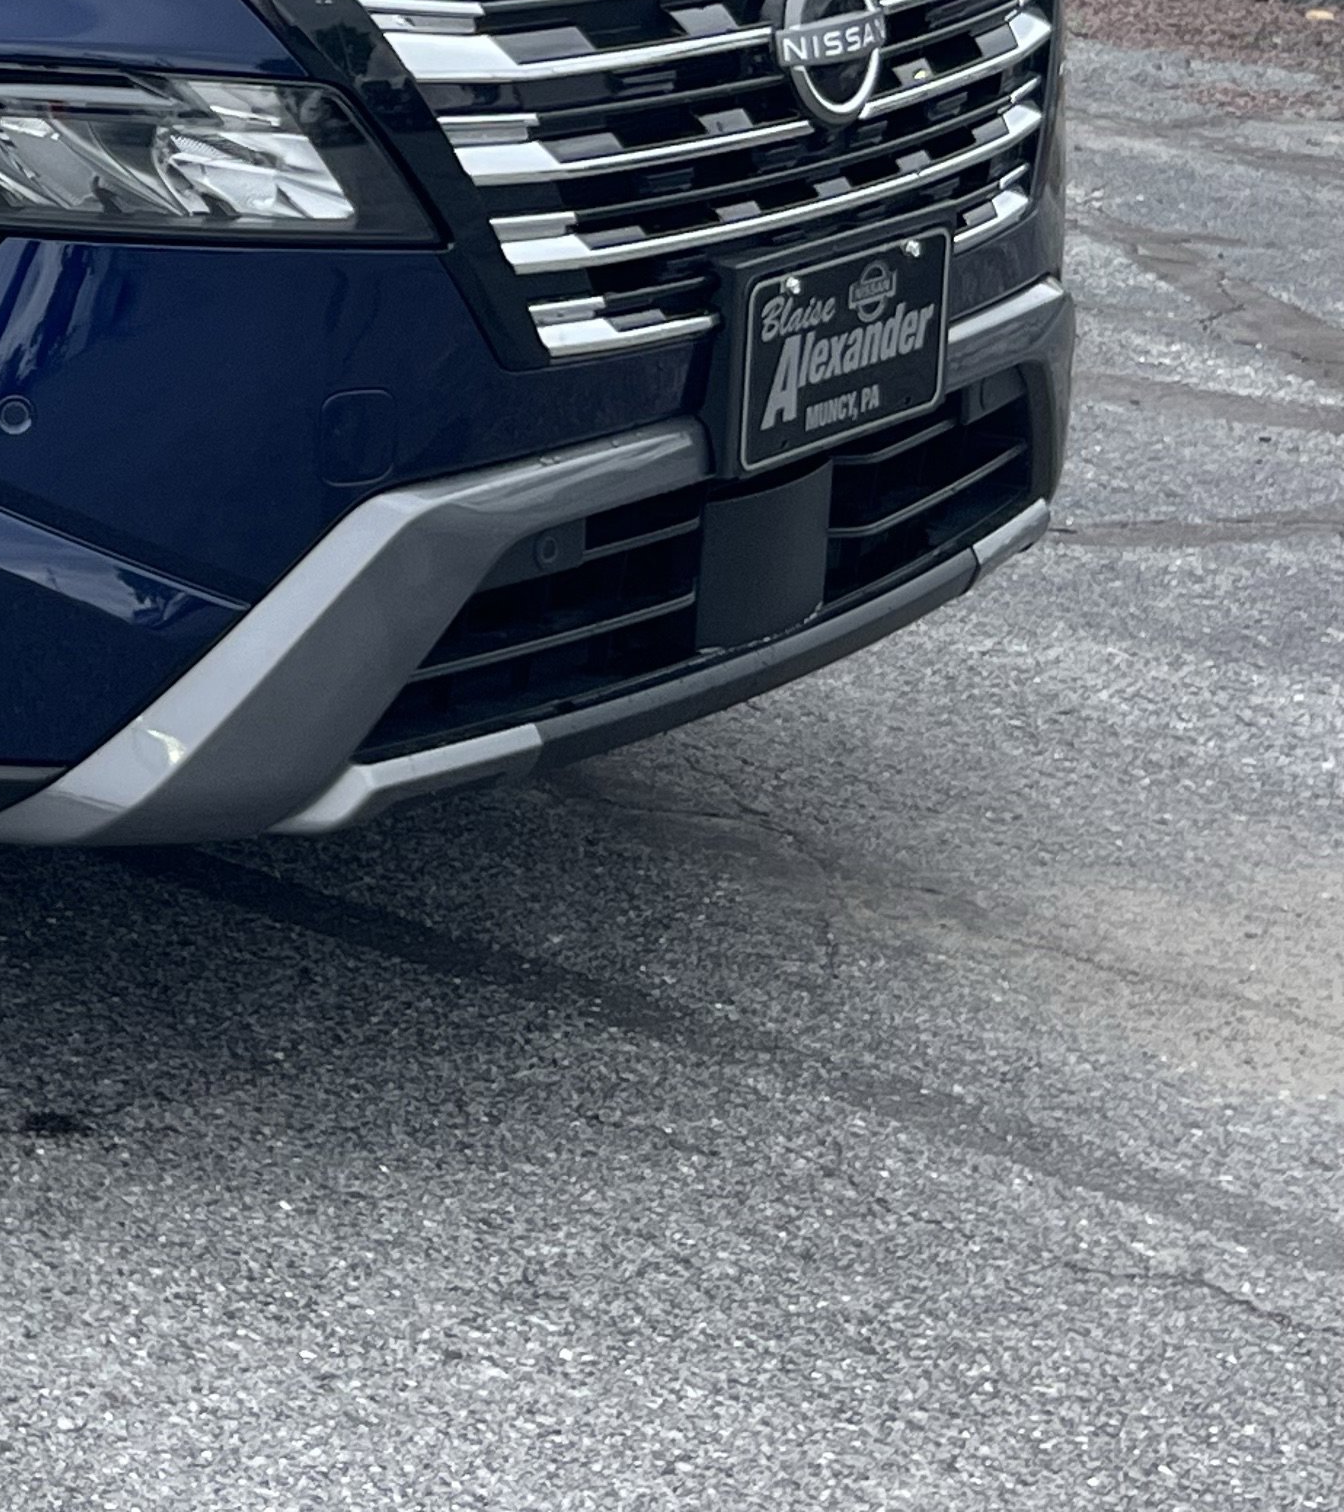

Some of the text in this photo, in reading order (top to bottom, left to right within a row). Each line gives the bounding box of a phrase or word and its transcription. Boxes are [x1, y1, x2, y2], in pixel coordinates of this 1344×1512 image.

[782, 18, 886, 62] NISSAN
[761, 295, 836, 343] Blaise
[759, 302, 935, 432] Alexander
[861, 384, 881, 413] PA
